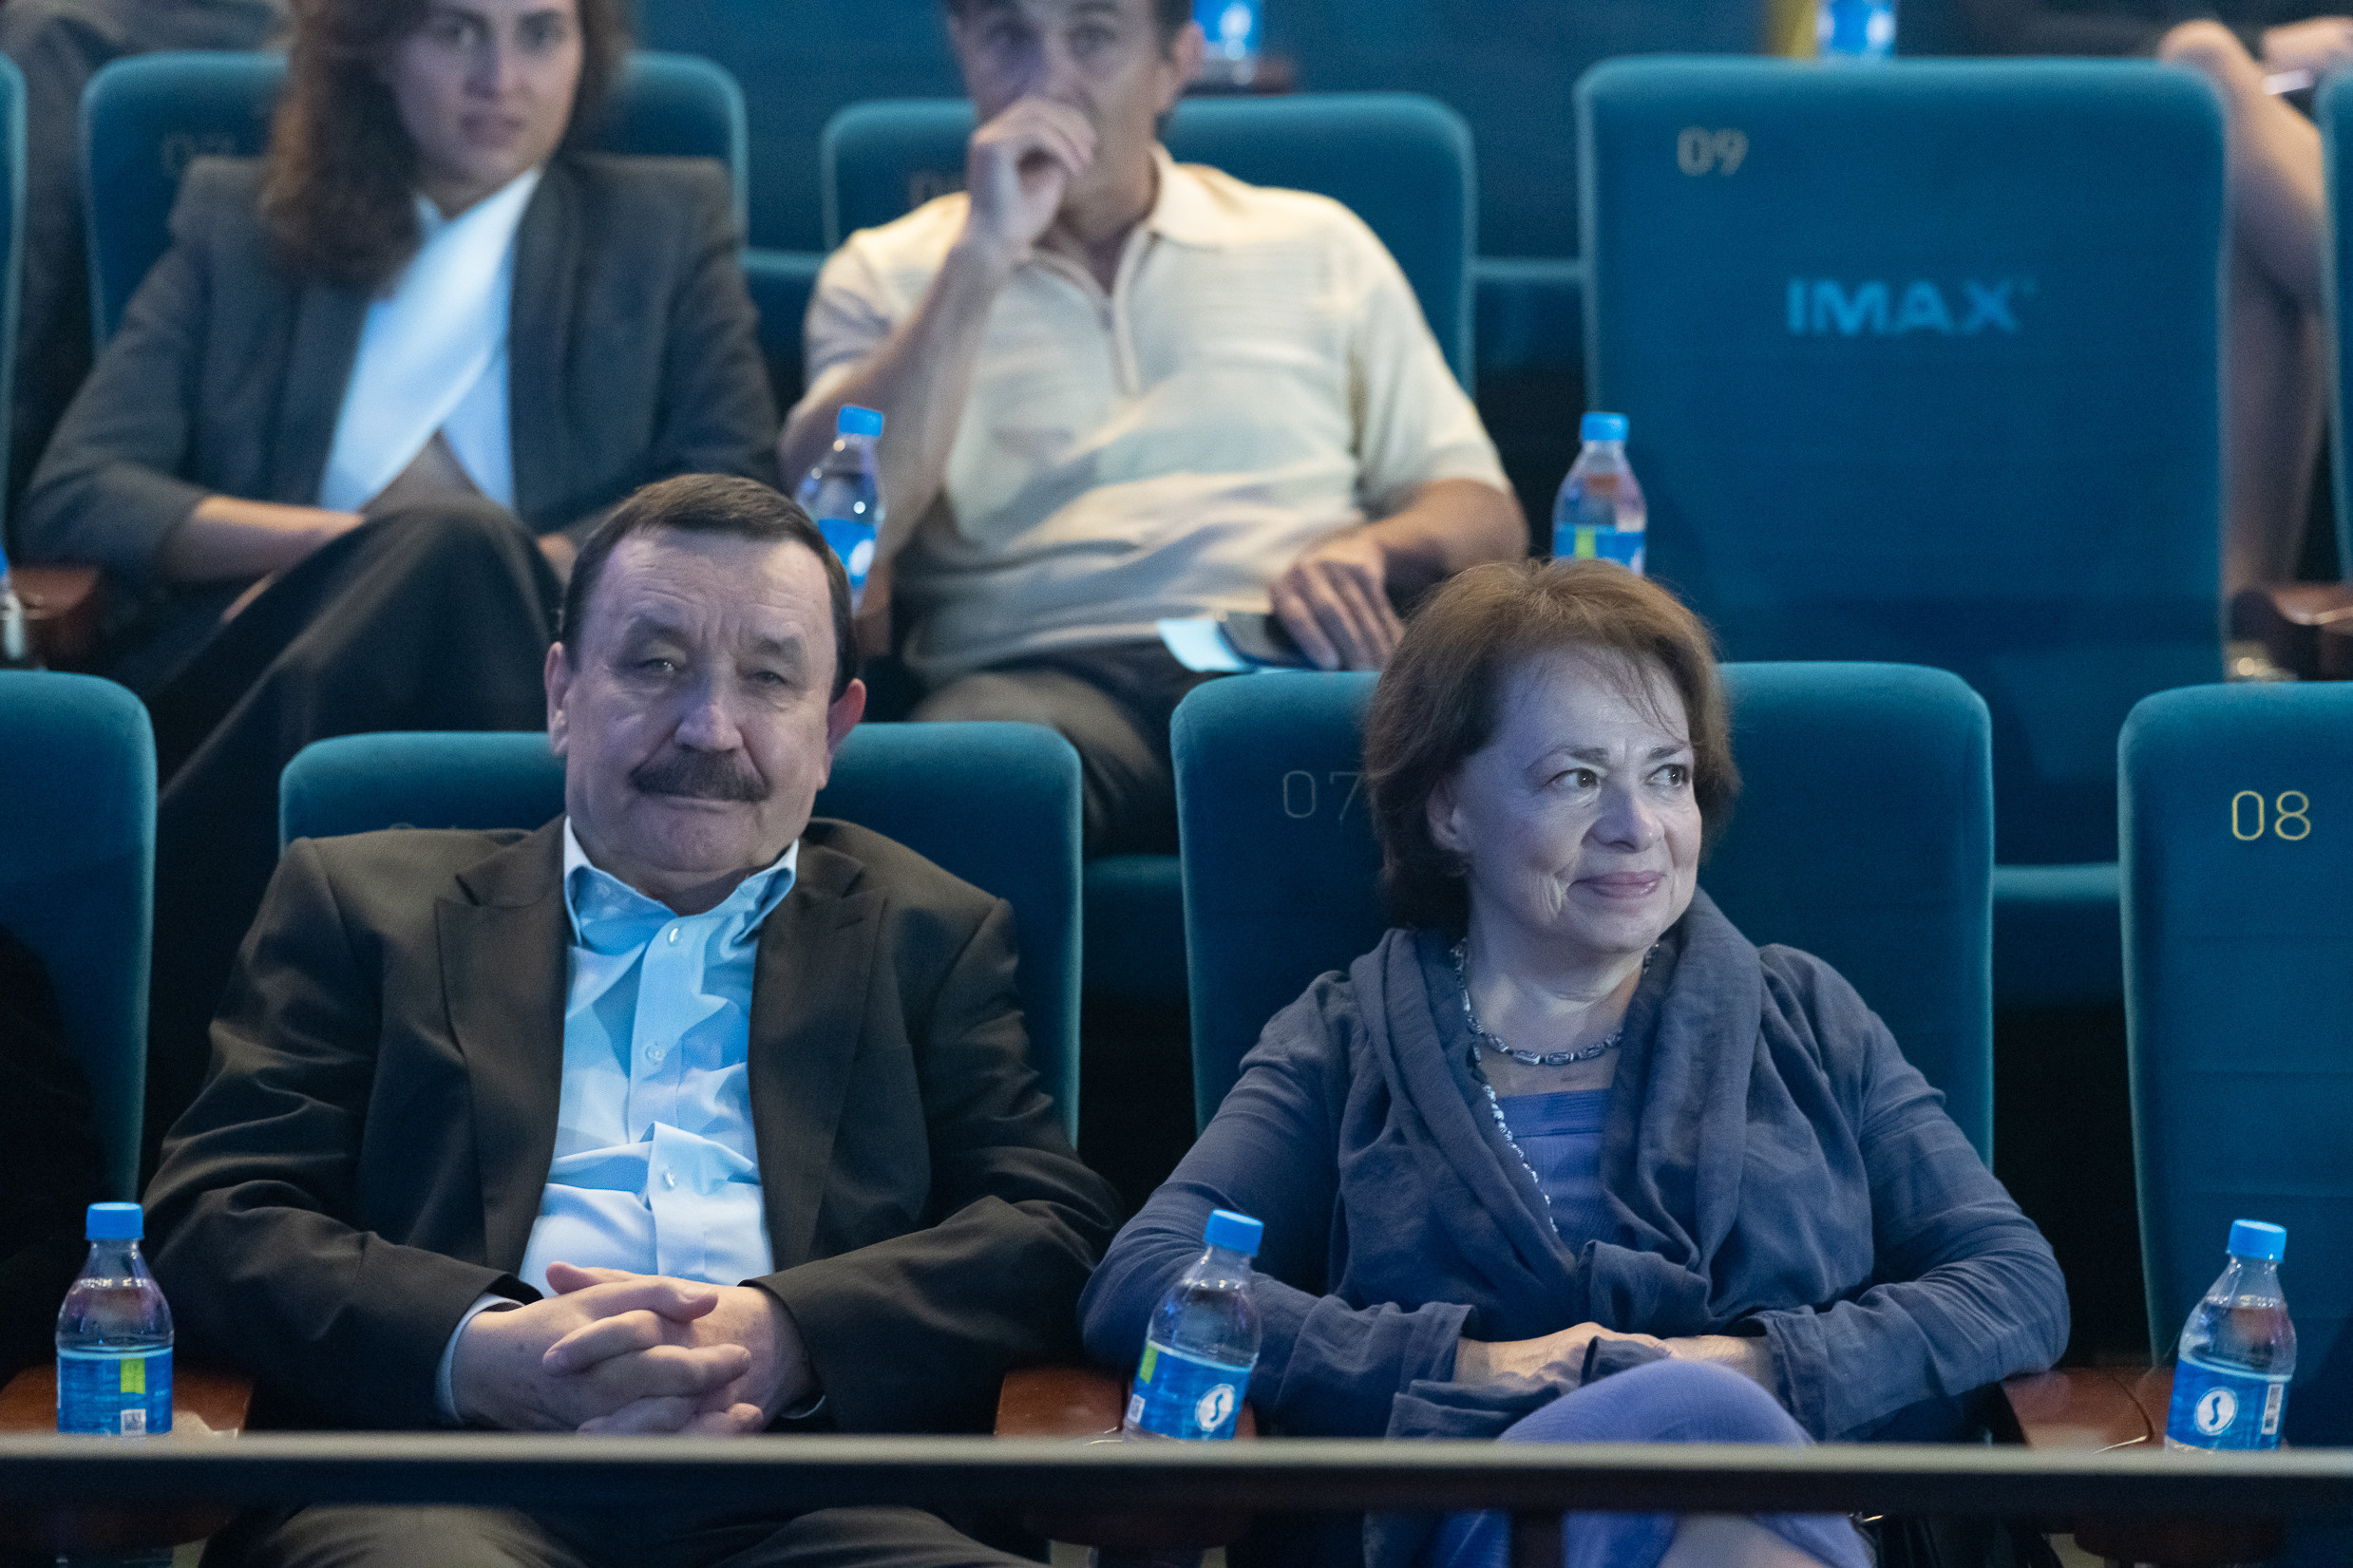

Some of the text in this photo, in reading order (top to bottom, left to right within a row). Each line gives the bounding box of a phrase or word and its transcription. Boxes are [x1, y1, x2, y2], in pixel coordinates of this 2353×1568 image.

[1676, 126, 1750, 178] 09
[1786, 277, 2024, 335] IMAX
[1282, 769, 1366, 822] 07
[2230, 789, 2312, 842] 08
